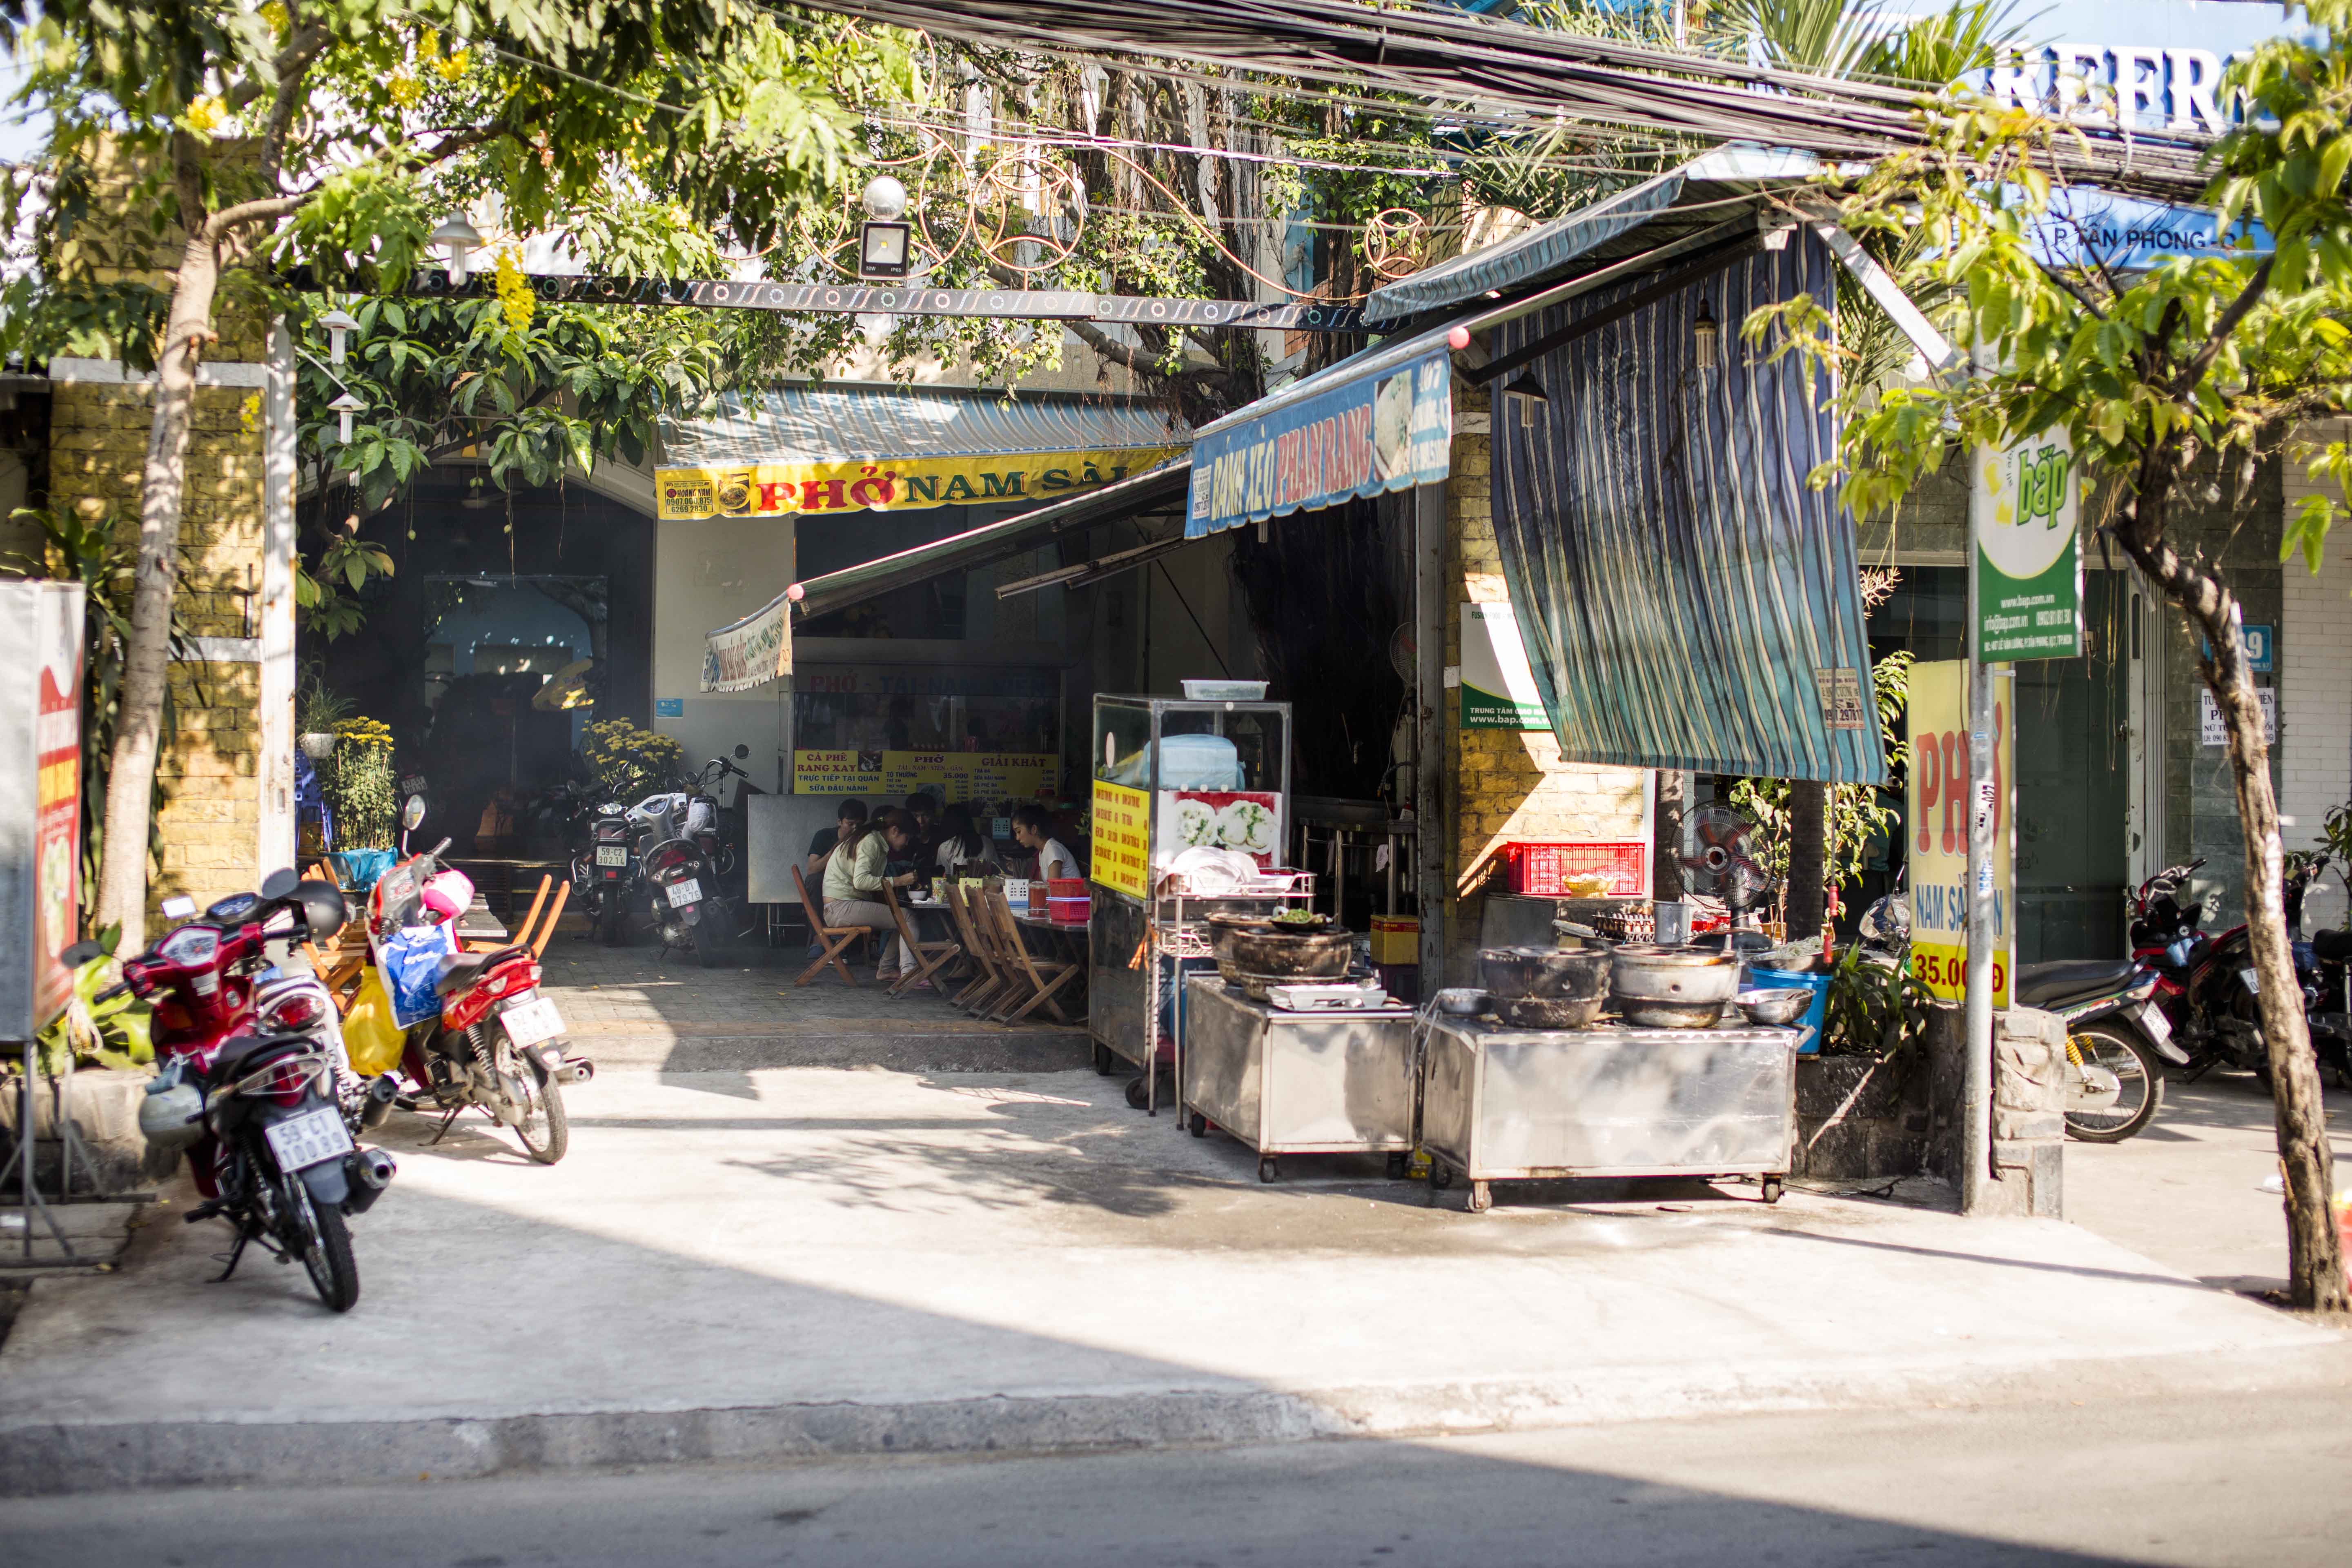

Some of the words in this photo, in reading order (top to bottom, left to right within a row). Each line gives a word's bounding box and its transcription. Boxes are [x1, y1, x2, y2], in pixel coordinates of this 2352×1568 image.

[2127, 229, 2206, 250] PHONG
[1211, 434, 1246, 521] BÁNH
[1245, 423, 1275, 513] XÈO
[1274, 421, 1323, 506] PHAN
[1323, 403, 1373, 495] RANG
[756, 466, 897, 511] PHỞ
[904, 471, 1028, 503] NAM
[2017, 443, 2069, 530] bắp
[699, 489, 710, 497] NAM
[1470, 715, 1550, 725] www.bap.com.v
[2205, 723, 2216, 732] NỮ
[806, 752, 822, 761] CÀ
[826, 752, 847, 761] PHÊ
[914, 754, 944, 763] PHỞ
[982, 755, 1008, 767] GIẢI
[1011, 756, 1046, 767] KHÁT
[601, 848, 622, 856] 59-C2
[598, 856, 624, 865] 302.14
[1916, 884, 1944, 930] NAM
